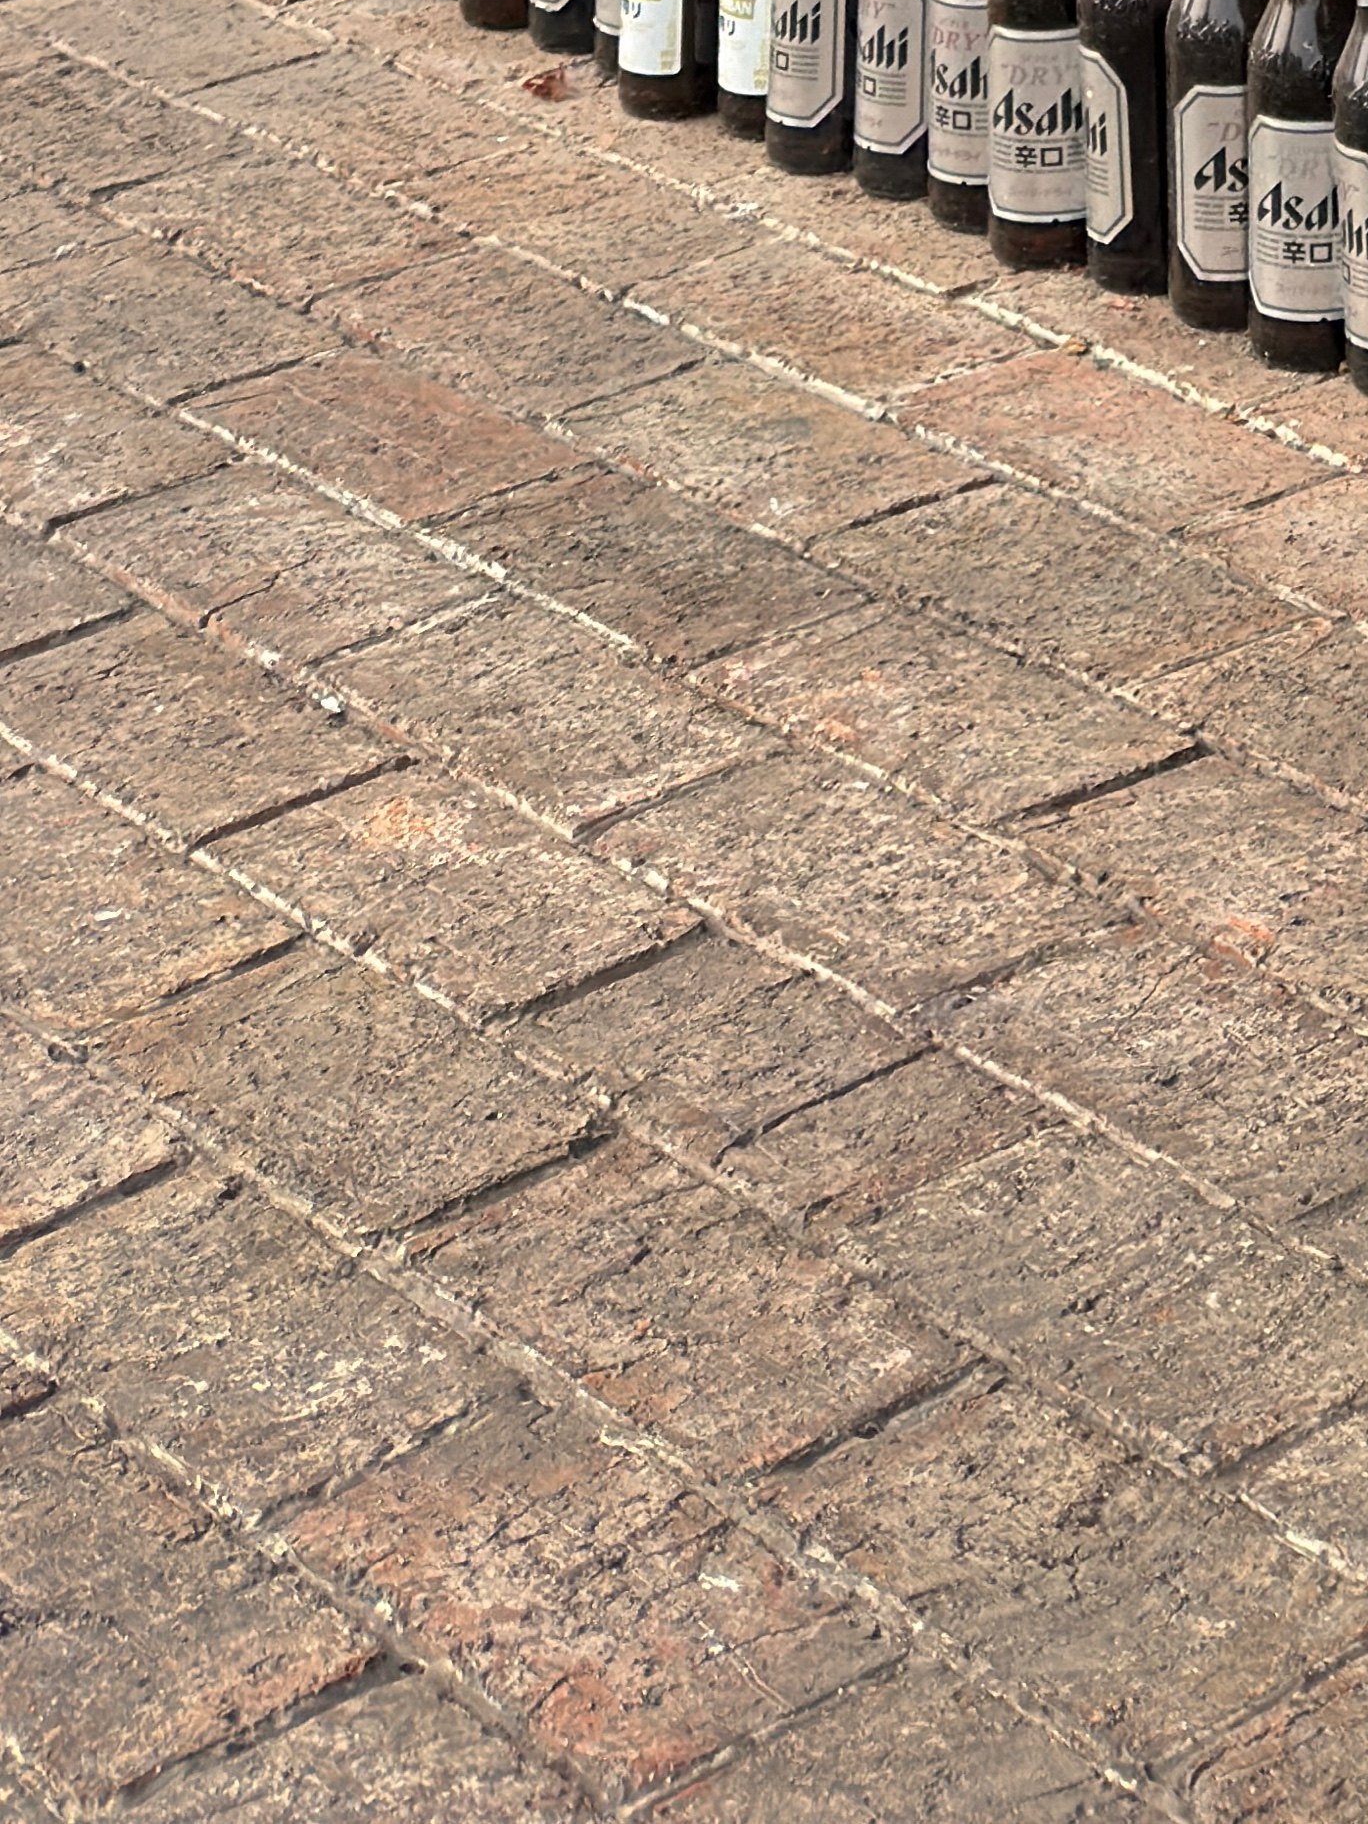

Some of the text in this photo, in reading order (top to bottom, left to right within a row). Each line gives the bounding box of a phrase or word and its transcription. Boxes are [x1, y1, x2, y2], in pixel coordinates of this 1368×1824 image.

[935, 104, 972, 131] 辛口
[1014, 145, 1063, 168] 辛口
[1283, 240, 1333, 264] 辛口
